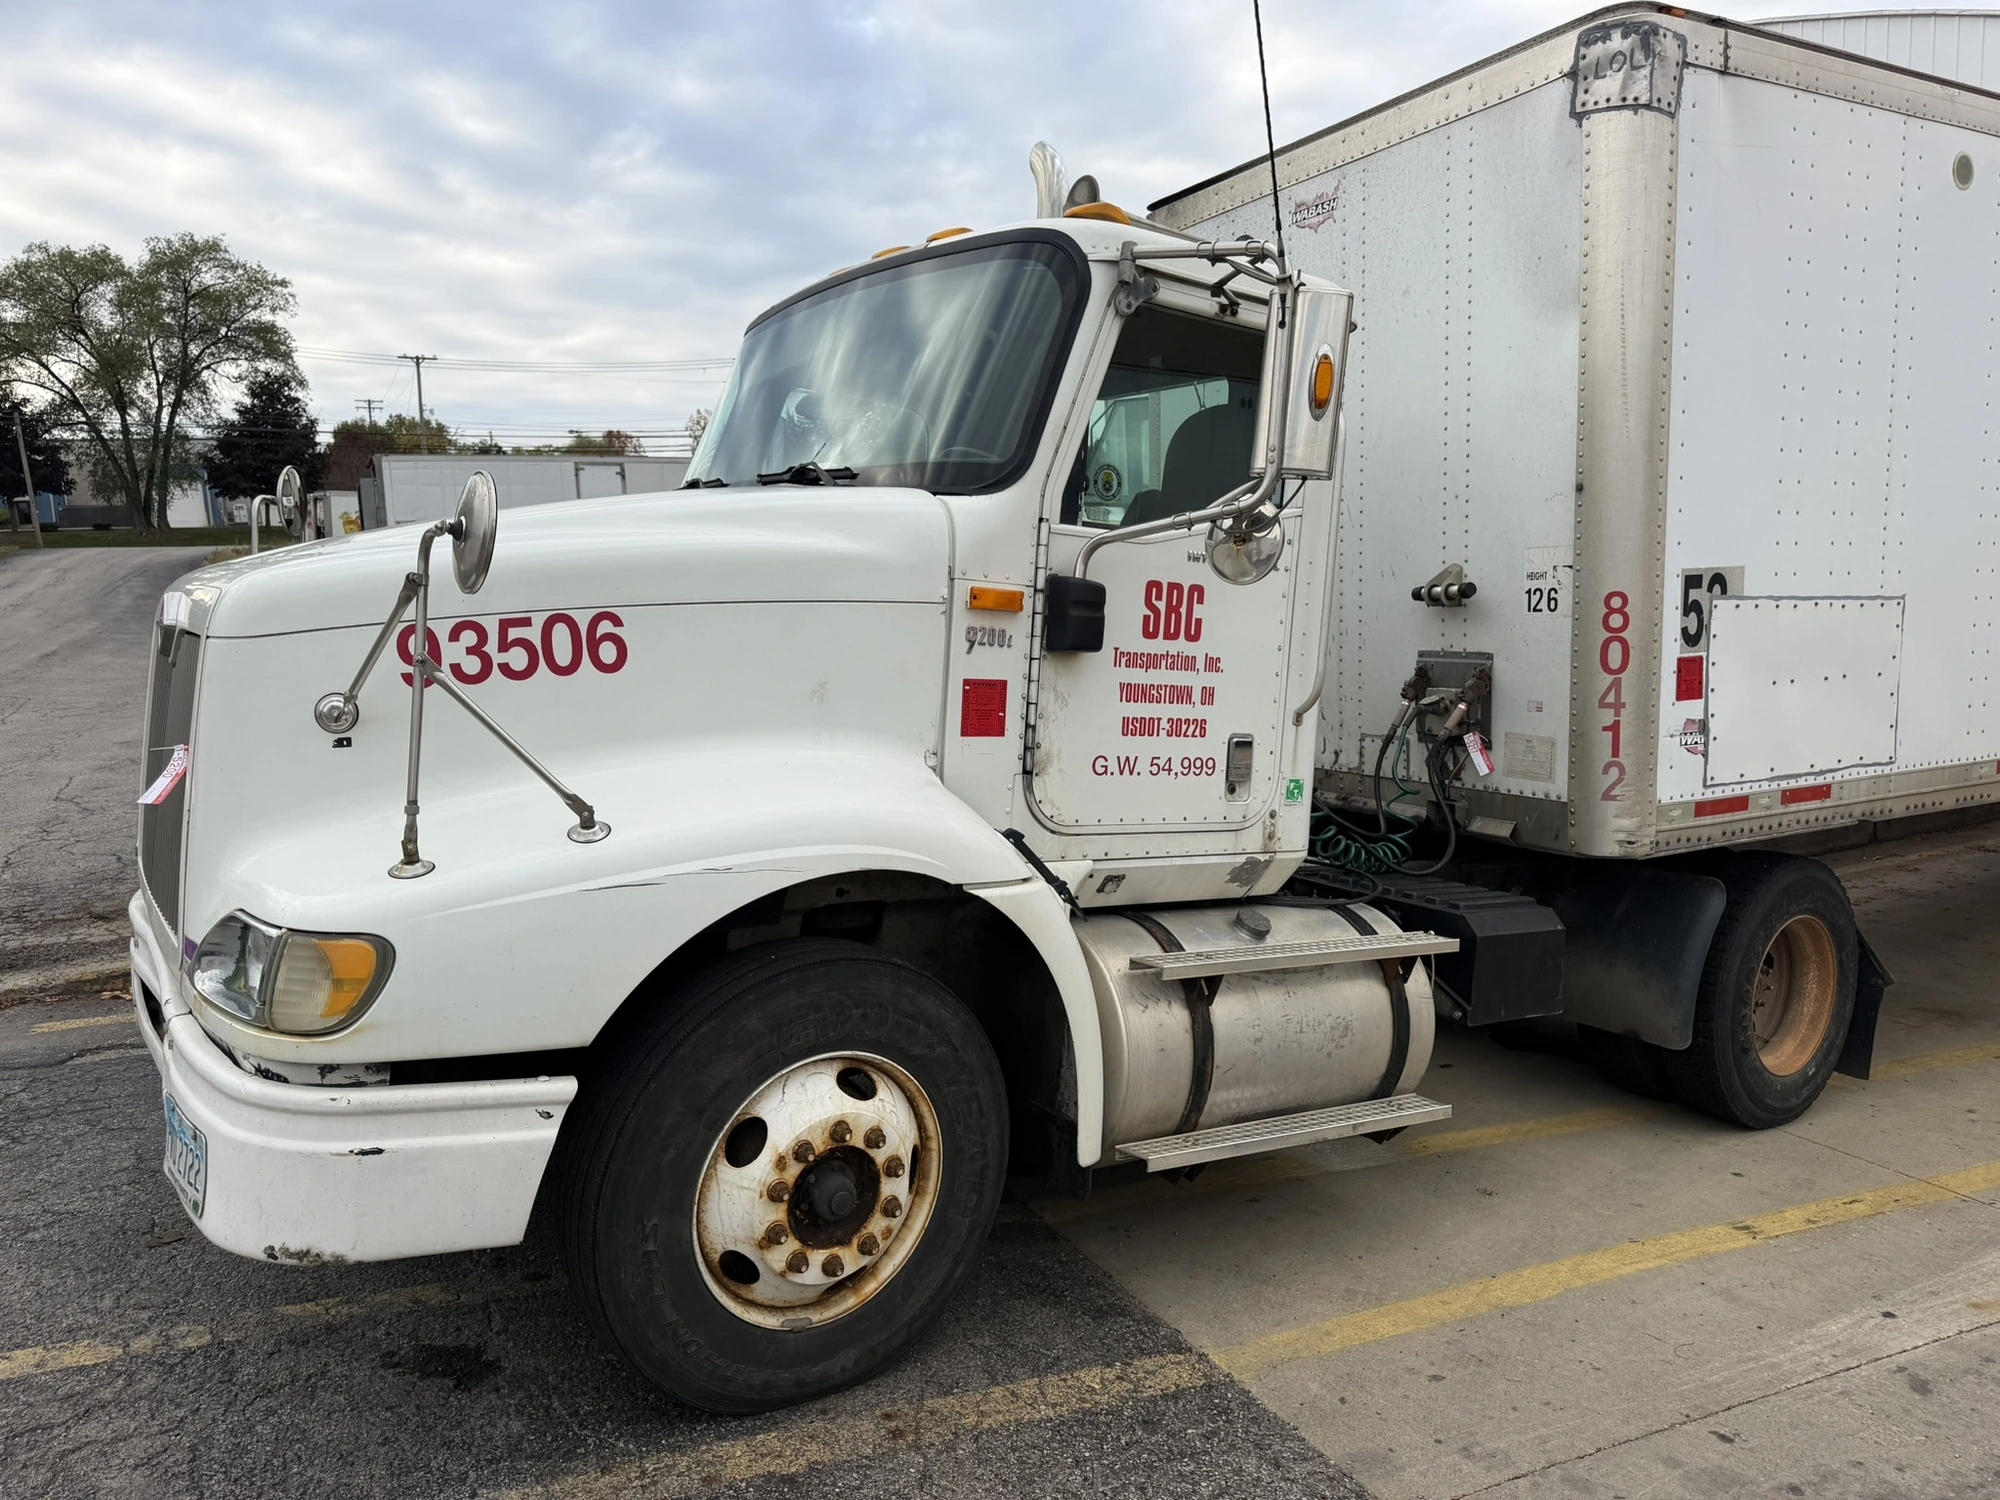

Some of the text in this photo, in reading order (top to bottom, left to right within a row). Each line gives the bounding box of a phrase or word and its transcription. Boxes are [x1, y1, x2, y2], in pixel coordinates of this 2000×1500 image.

[1292, 198, 1338, 224] WABASH
[1526, 571, 1548, 581] HEIGHT
[1142, 579, 1205, 643] SBC
[396, 611, 628, 689] 93506
[1113, 646, 1224, 676] Transportation, Inc.
[1119, 681, 1215, 709] YOUNGSTOWN, OH
[1598, 590, 1630, 802] 80412
[1121, 716, 1208, 738] USDOT-30226
[162, 747, 183, 779] 1-5200
[1092, 754, 1217, 780] G.W. 54,999
